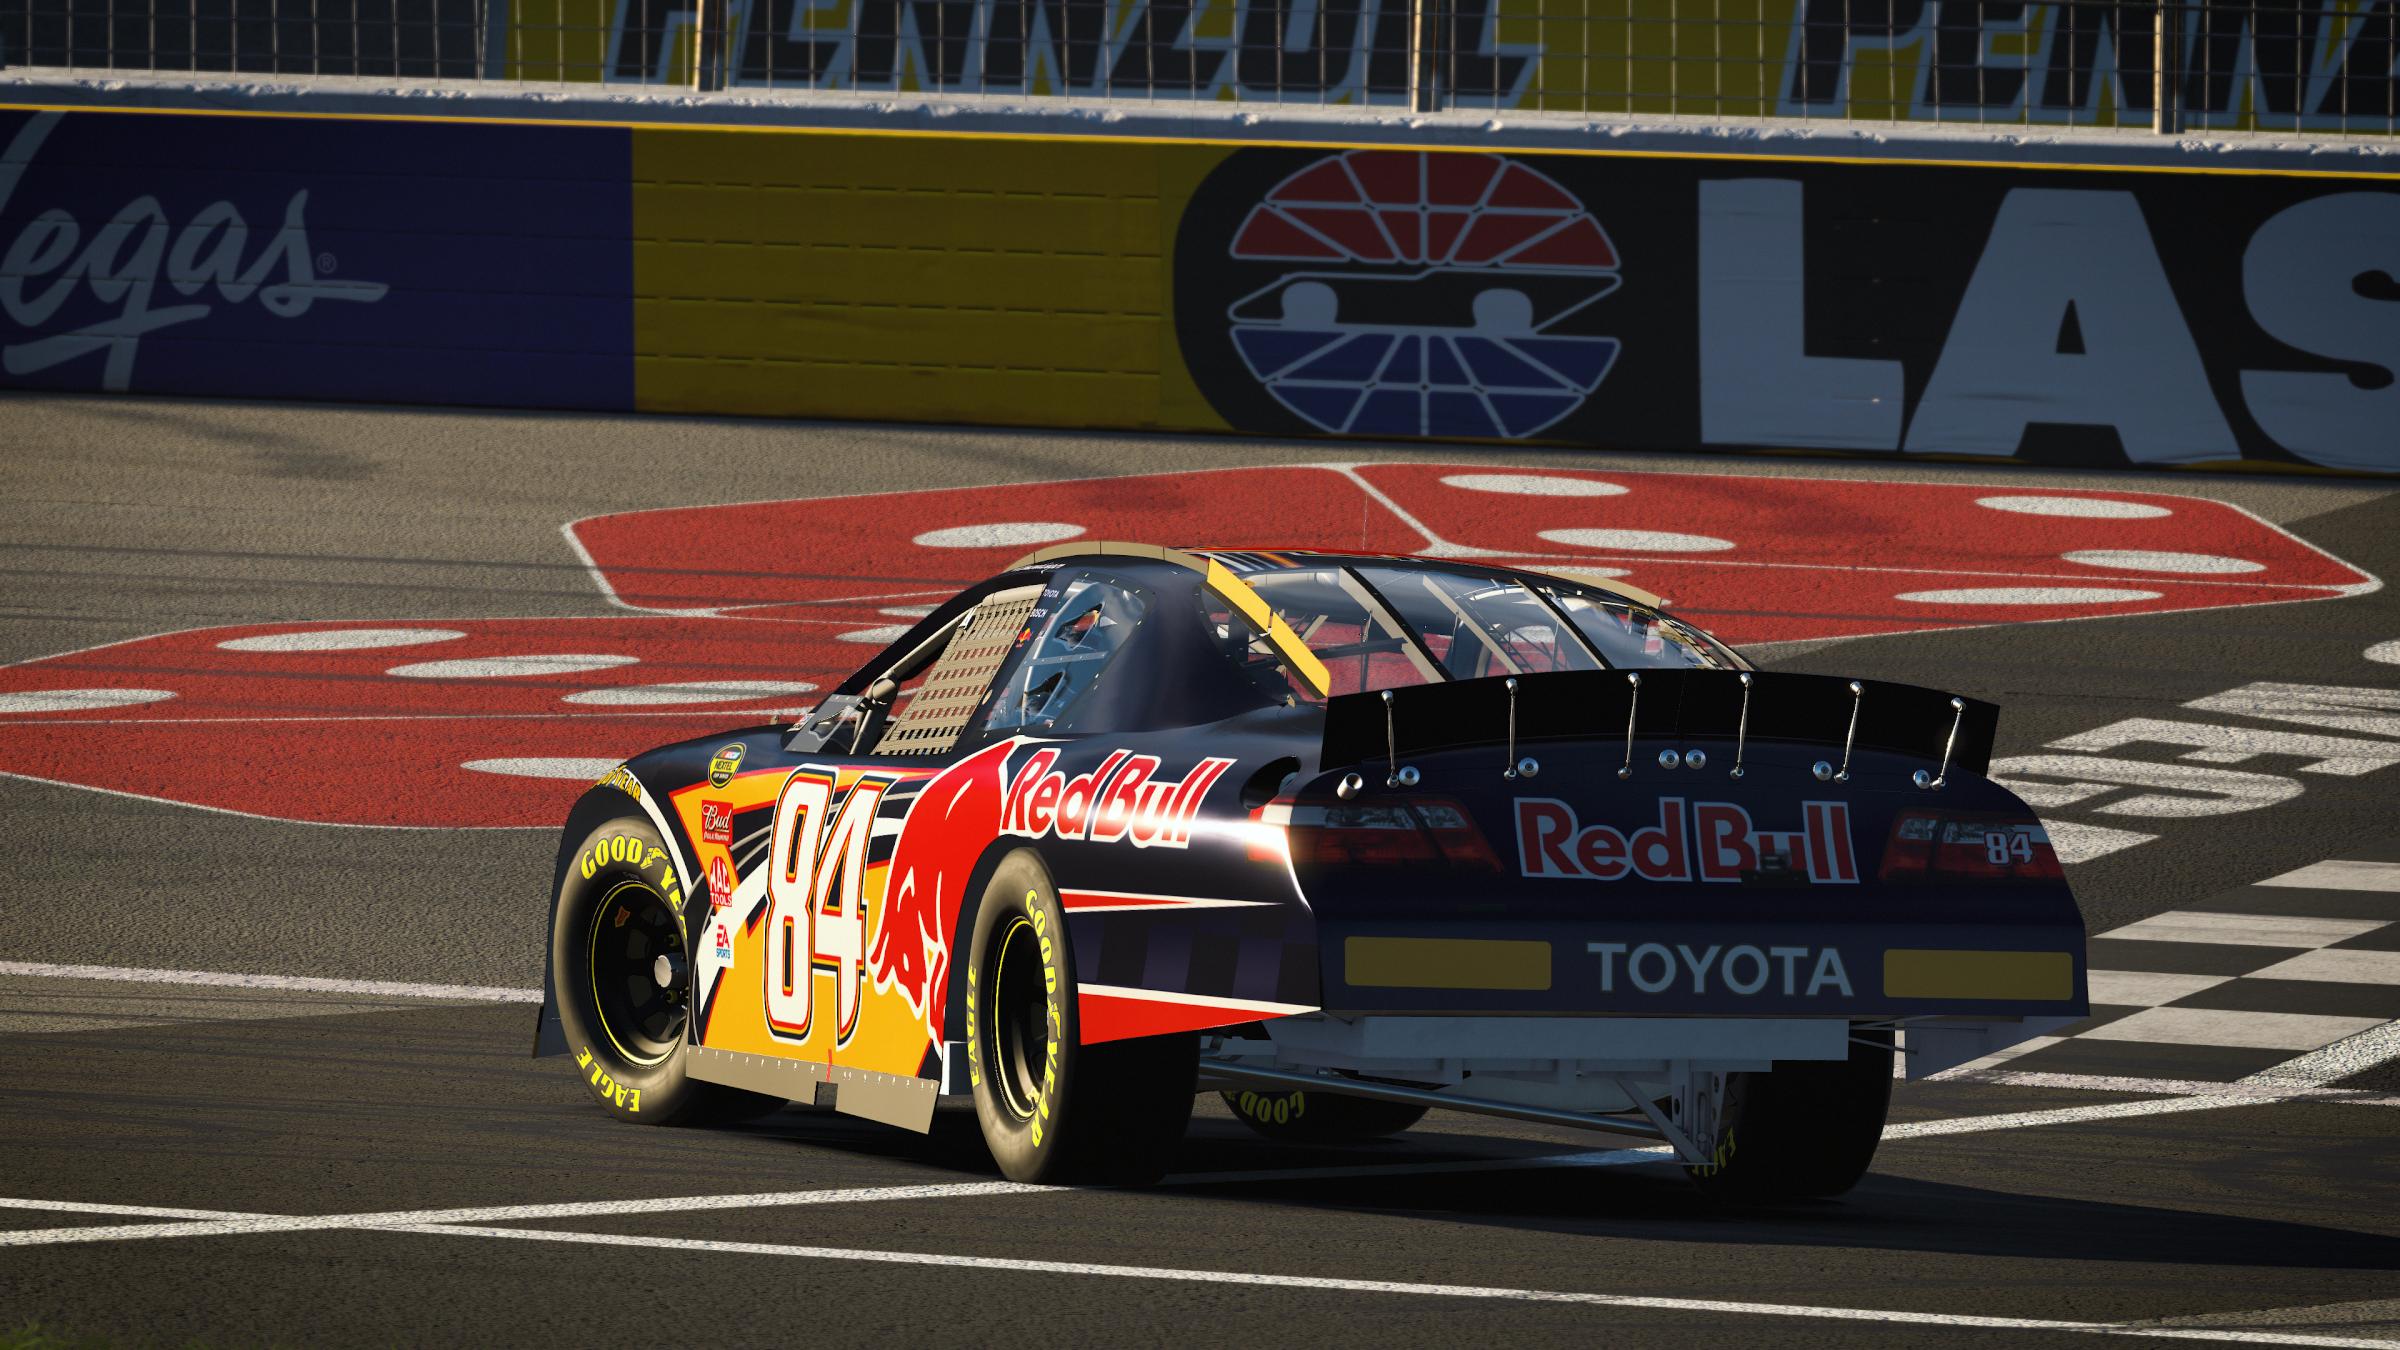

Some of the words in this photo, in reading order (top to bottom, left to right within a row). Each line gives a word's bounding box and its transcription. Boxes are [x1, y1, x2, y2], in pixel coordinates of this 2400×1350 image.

[702, 804, 732, 830] Bud
[580, 835, 644, 880] GOOD
[1984, 831, 2034, 865] 84
[710, 857, 730, 893] MAC
[710, 893, 732, 906] TOOLS
[765, 764, 900, 1050] 84
[716, 924, 730, 948] EA
[716, 948, 731, 960] SPORTS
[1025, 888, 1057, 994] GOOD
[1587, 943, 1854, 997] TOYOTA
[966, 964, 980, 1088] EAGLE
[575, 1045, 641, 1112] EAGLE
[1031, 1040, 1060, 1148] YEAR
